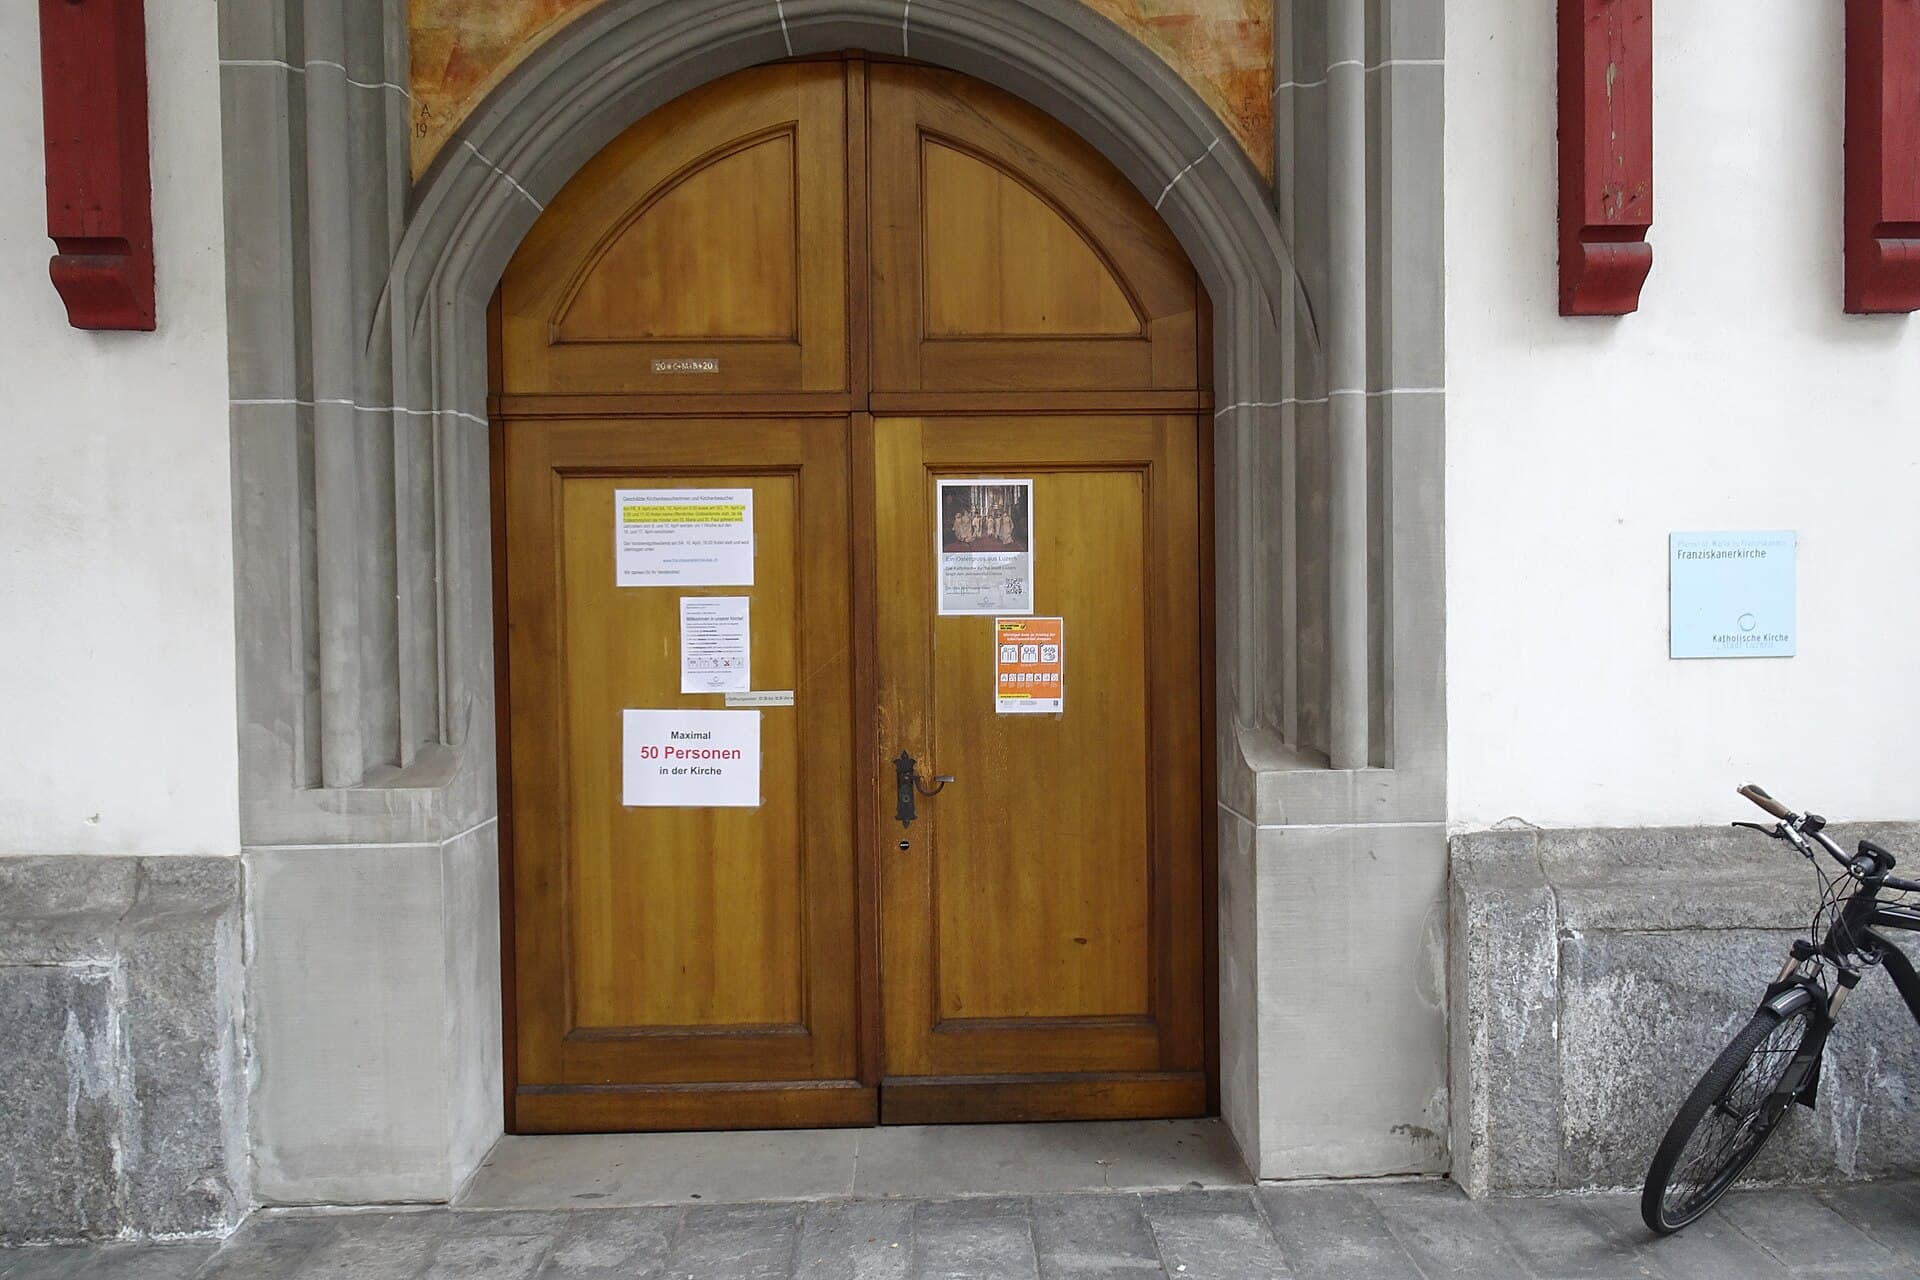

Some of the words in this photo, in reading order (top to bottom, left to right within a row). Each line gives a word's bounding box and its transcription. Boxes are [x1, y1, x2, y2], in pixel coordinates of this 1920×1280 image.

[421, 104, 432, 118] A
[1677, 549, 1767, 560] Franziskanerkirche
[1712, 634, 1761, 644] Katholische
[1764, 633, 1789, 642] Kirche
[670, 731, 712, 740] Maximal
[640, 746, 659, 760] 50
[664, 746, 742, 760] Personen
[660, 766, 668, 775] in
[671, 766, 688, 775] der
[690, 766, 722, 775] Kirche
